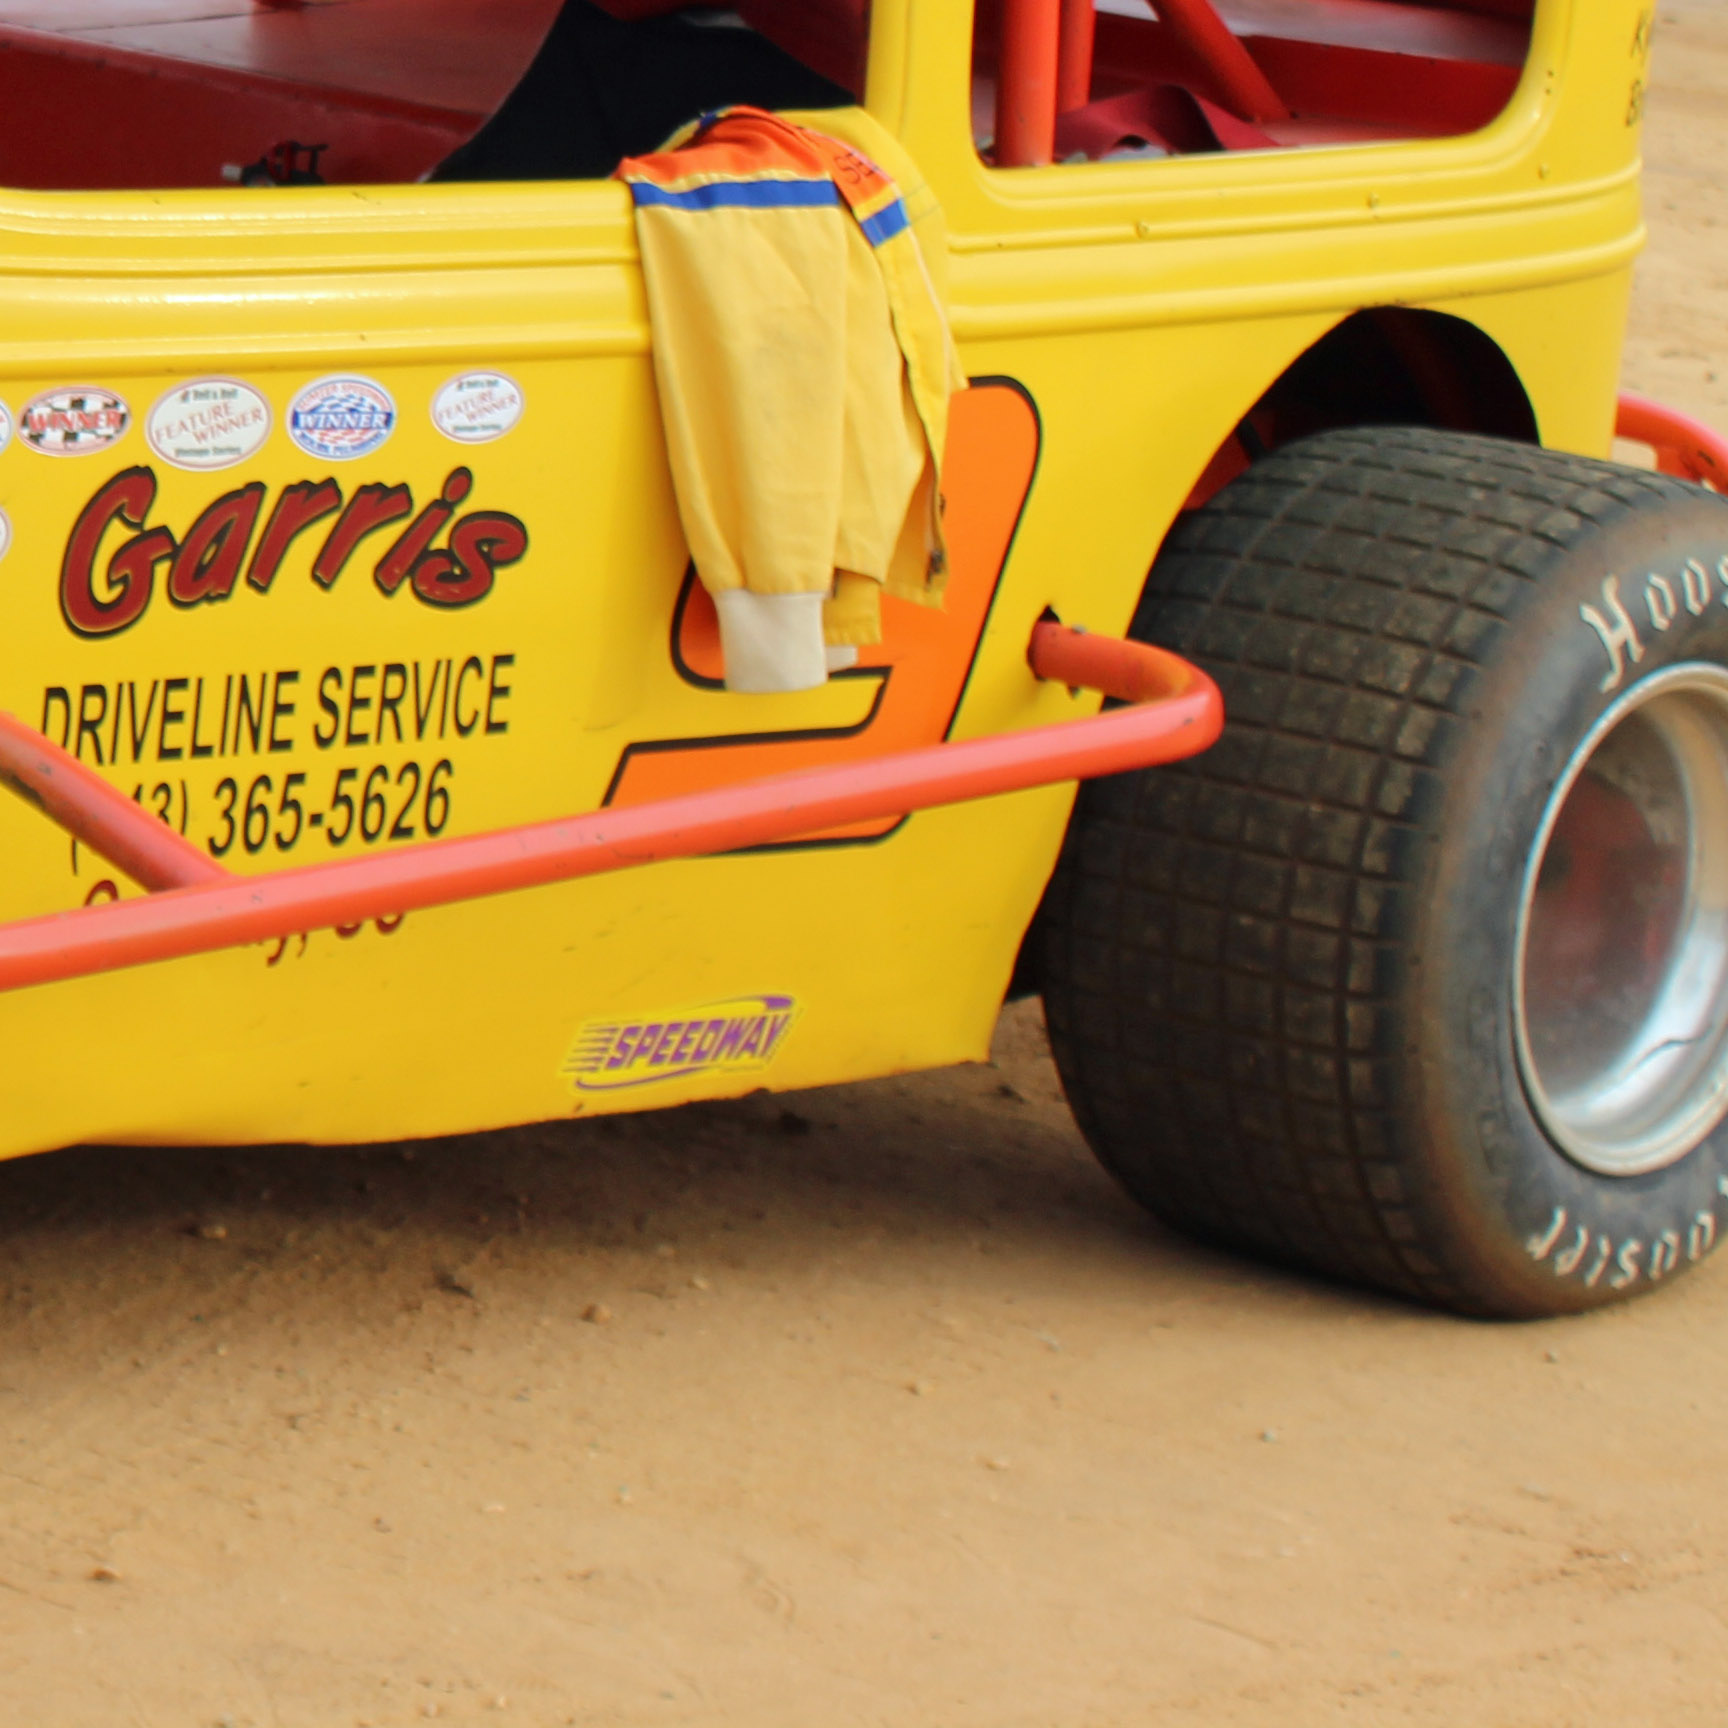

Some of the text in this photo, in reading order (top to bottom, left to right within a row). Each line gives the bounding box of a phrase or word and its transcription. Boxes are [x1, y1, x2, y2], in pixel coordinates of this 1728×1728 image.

[26, 408, 123, 434] WINNER
[154, 402, 232, 444] FEATURE
[192, 406, 263, 445] WINNER
[299, 413, 387, 428] WINNER
[438, 389, 494, 423] FEATURE
[465, 393, 518, 422] WINNER
[59, 465, 529, 641] Garris
[43, 652, 516, 767] DRIVELINE SERVICE
[207, 758, 454, 858] 365-5626
[604, 1013, 792, 1070] SPEEDWAY
